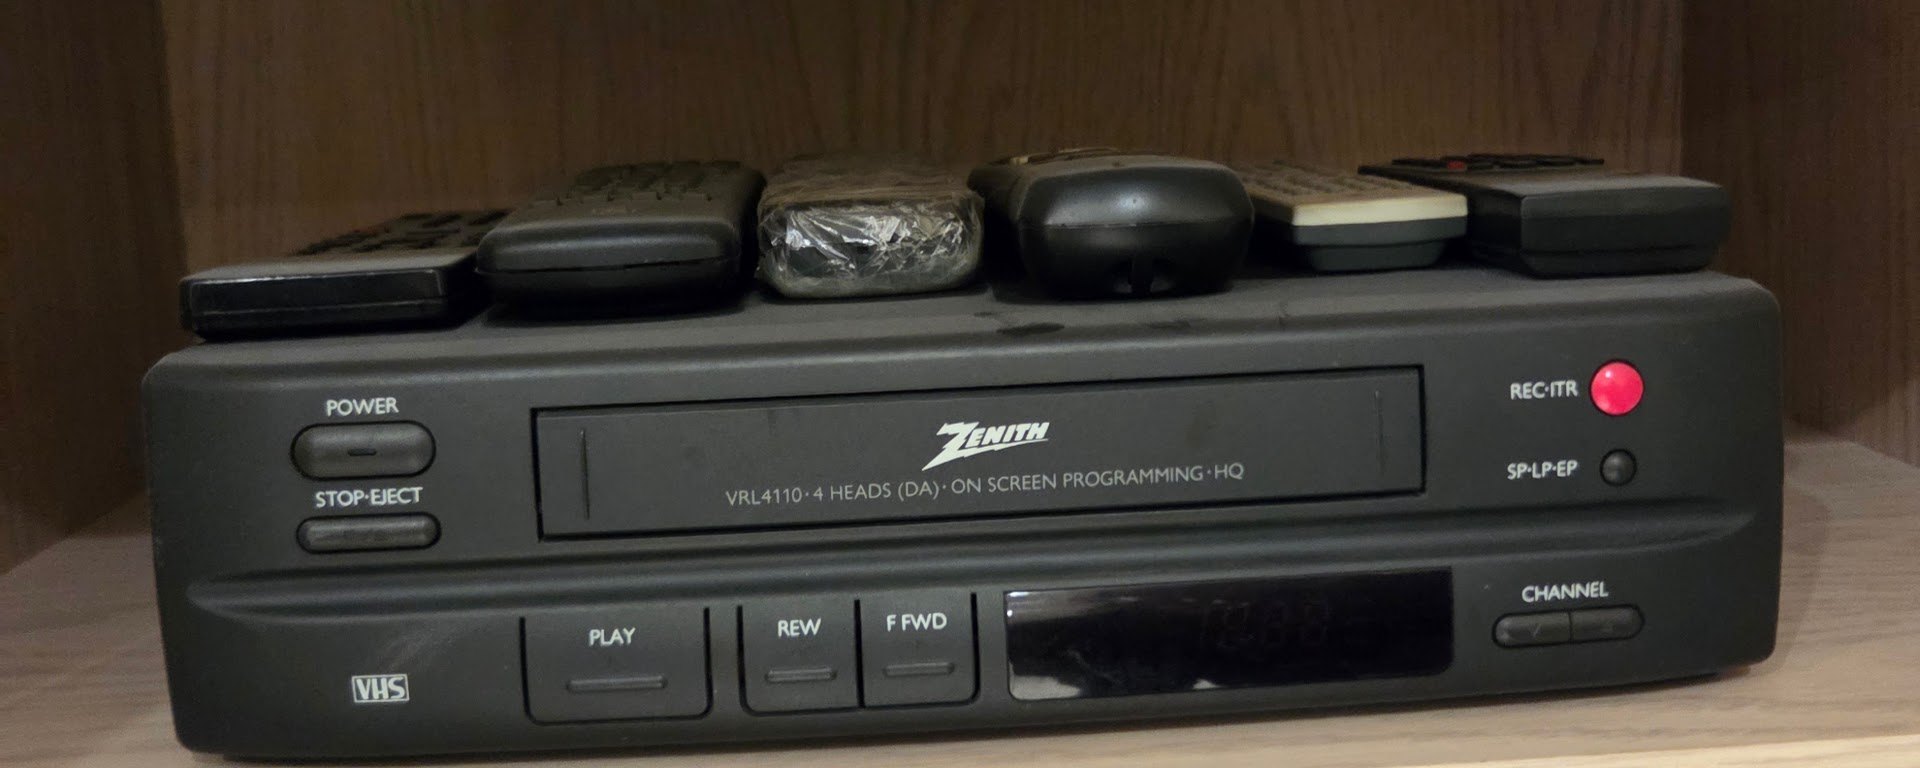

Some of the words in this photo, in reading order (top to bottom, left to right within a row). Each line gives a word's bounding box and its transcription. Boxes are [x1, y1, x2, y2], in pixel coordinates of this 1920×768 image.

[326, 397, 400, 417] POWER
[830, 482, 891, 501] HEADS
[951, 477, 981, 494] ON
[988, 474, 1056, 493] SCREEN
[1063, 466, 1203, 488] PROGRAMMING
[1214, 463, 1244, 480] HQ
[1522, 581, 1609, 602] CHANNEL
[777, 618, 821, 637] REW
[901, 612, 947, 630] FWD
[588, 628, 635, 646] PLAY
[355, 676, 406, 701] VHS
